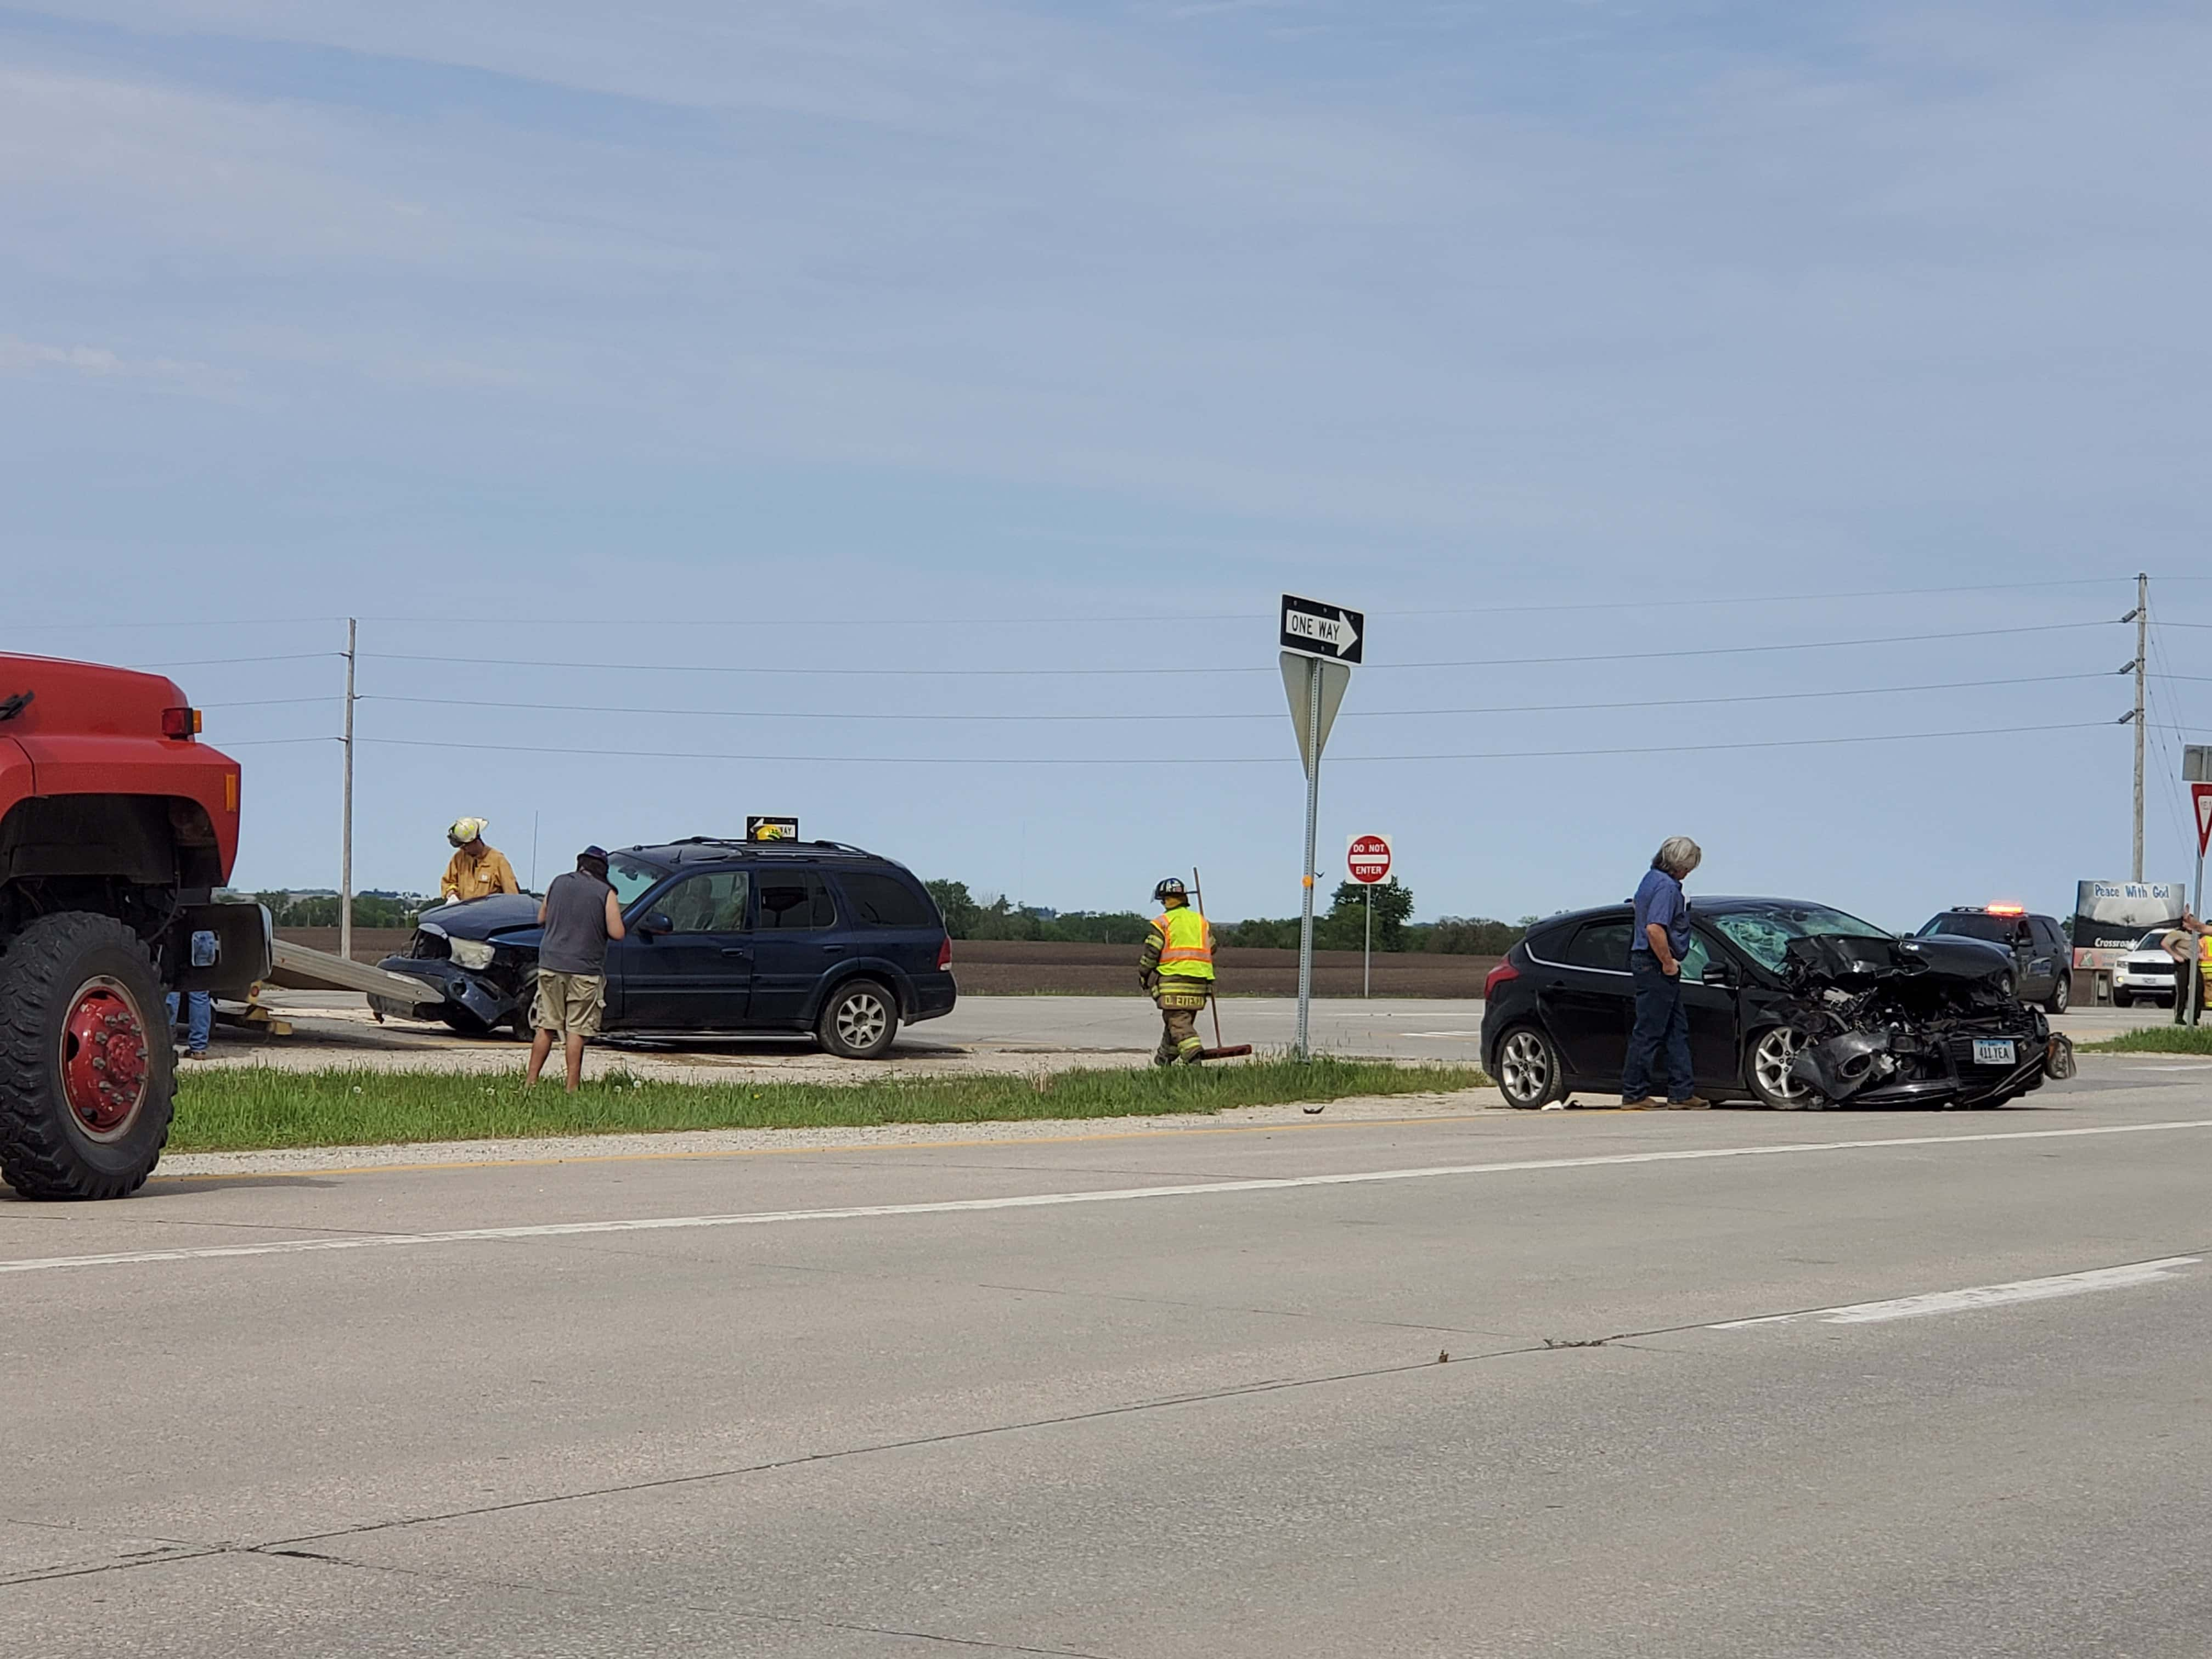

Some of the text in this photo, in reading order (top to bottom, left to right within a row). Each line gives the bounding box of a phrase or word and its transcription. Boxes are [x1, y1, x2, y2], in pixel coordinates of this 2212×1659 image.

[1291, 614, 1340, 641] ONE WAY
[1353, 843, 1385, 853] DO NOT
[1356, 866, 1382, 874] ENTER
[2095, 884, 2170, 899] Peace With God
[1979, 1047, 2010, 1059] 411 YEA
